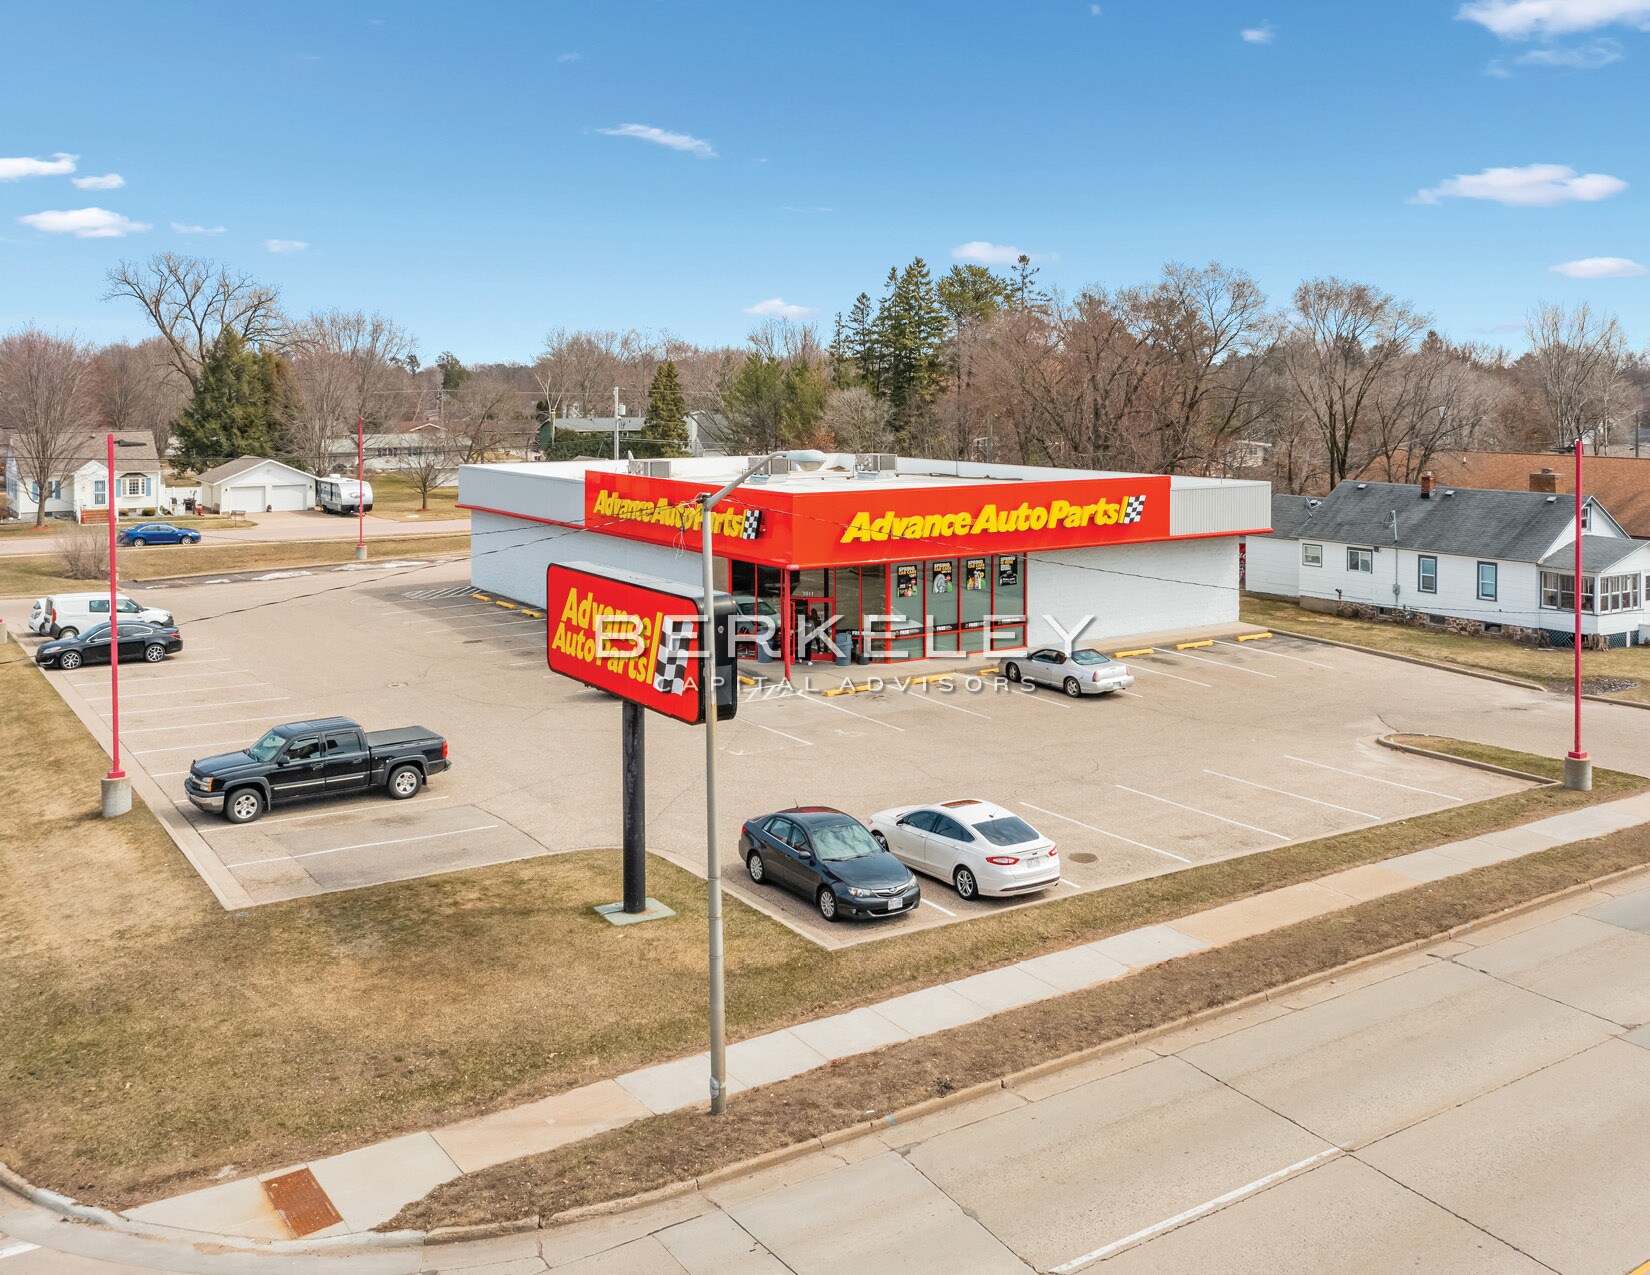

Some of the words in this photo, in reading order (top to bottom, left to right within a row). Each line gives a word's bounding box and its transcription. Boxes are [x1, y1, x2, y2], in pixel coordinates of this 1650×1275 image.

[593, 489, 655, 523] Advance
[840, 511, 972, 543] Advance
[971, 502, 1047, 534] Auto
[1046, 498, 1120, 528] Parts
[561, 587, 652, 647] Advance
[552, 622, 597, 662] Auto
